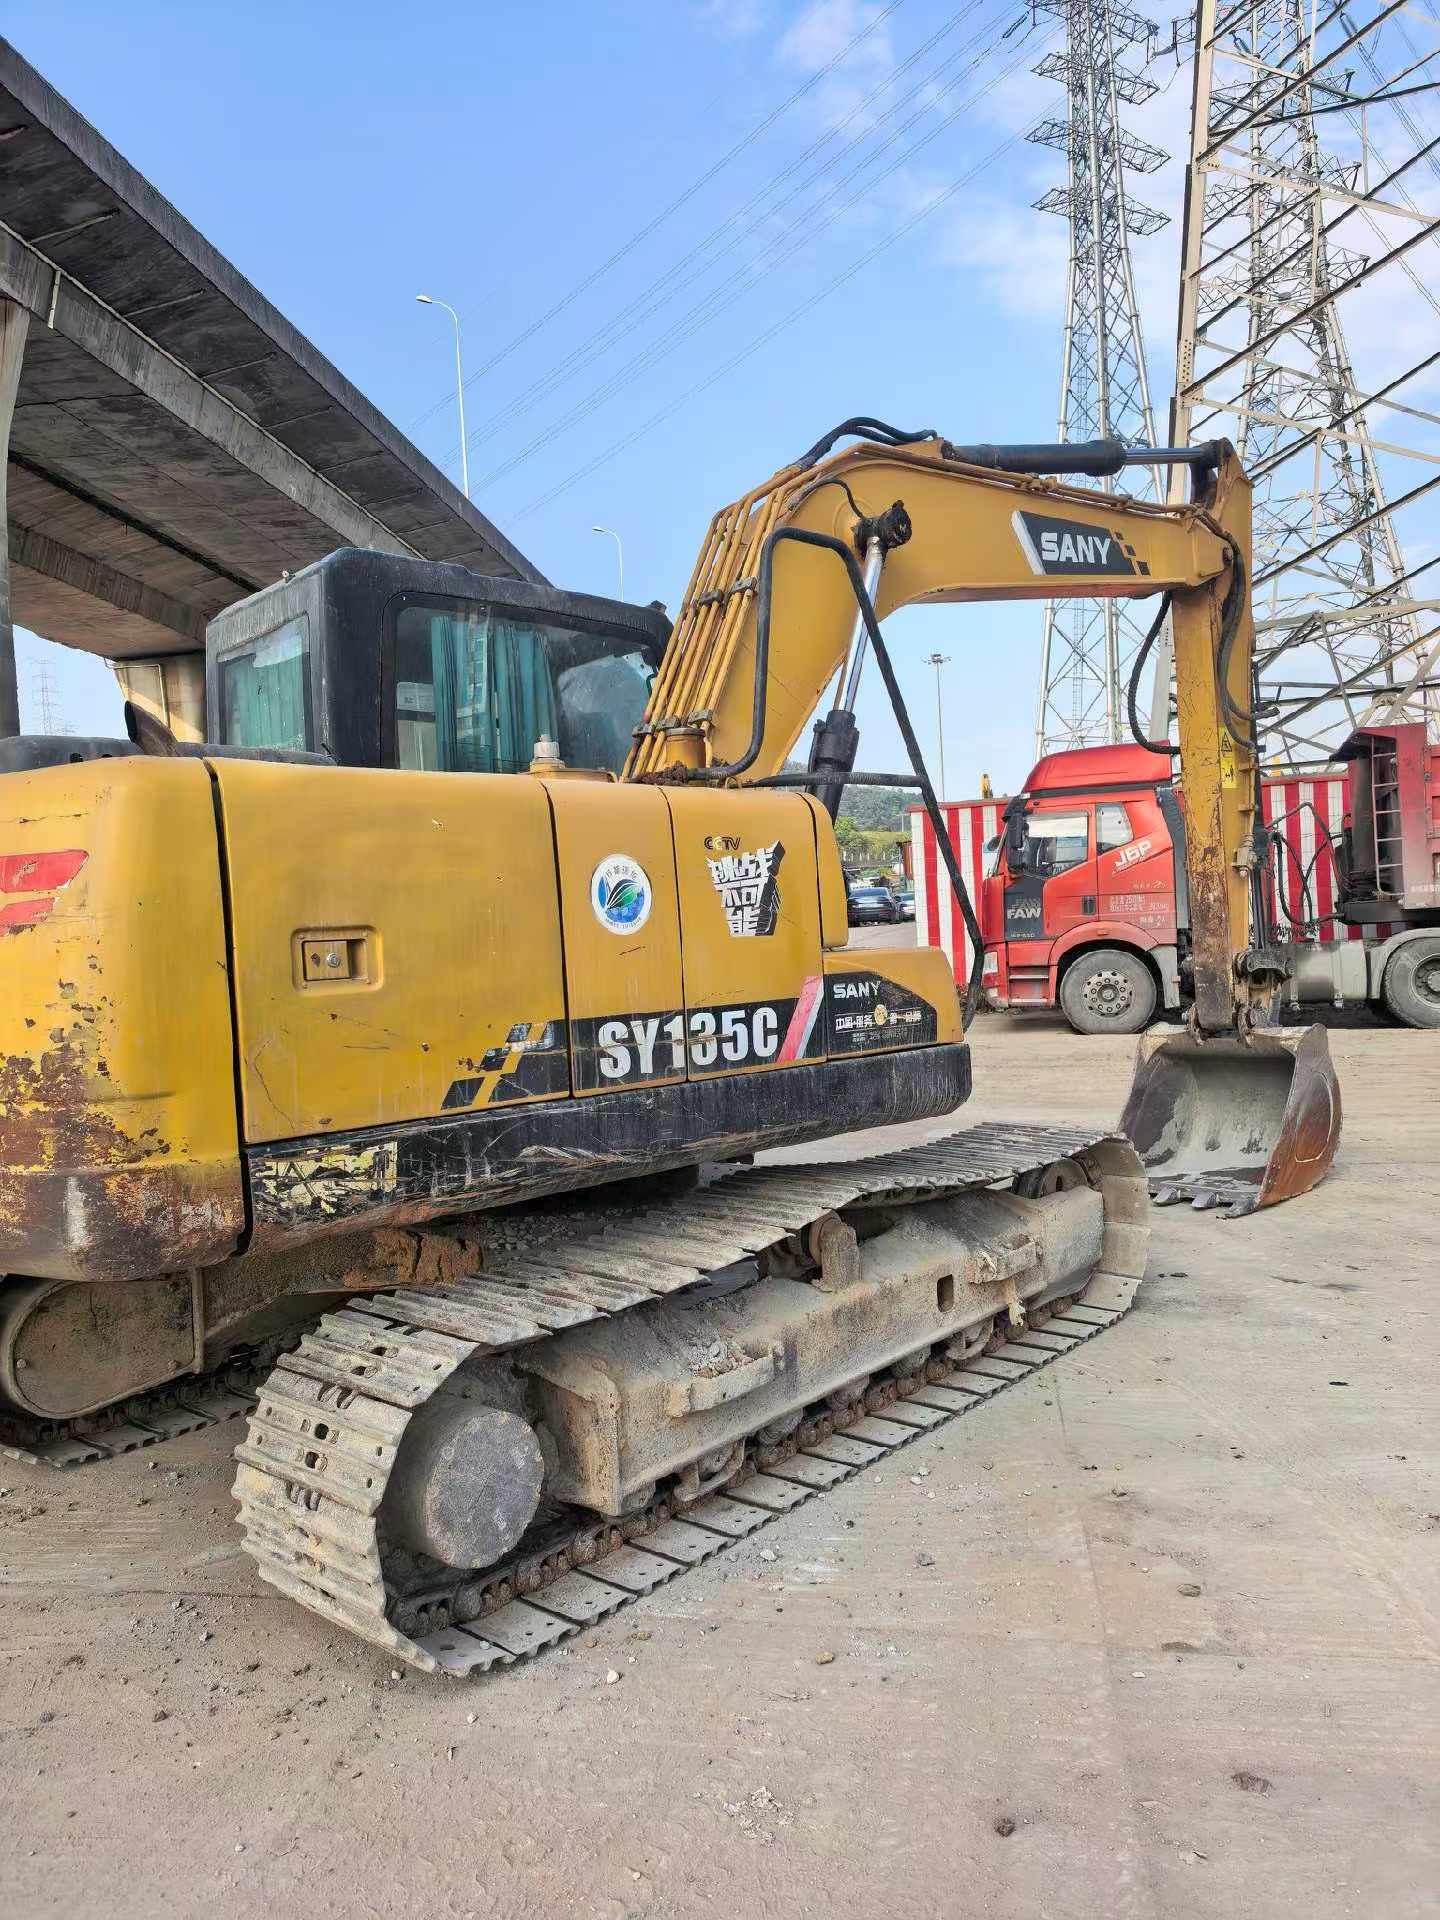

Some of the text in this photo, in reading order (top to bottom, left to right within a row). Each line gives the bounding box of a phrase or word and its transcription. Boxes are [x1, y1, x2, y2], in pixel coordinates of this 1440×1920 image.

[1040, 531, 1112, 565] SANY
[704, 836, 741, 851] CCTV
[706, 842, 777, 883] 挑战
[714, 878, 768, 908] 不可
[726, 906, 760, 936] 能
[1007, 907, 1042, 919] FAW
[833, 981, 881, 999] SANY
[598, 1006, 779, 1079] SY135C
